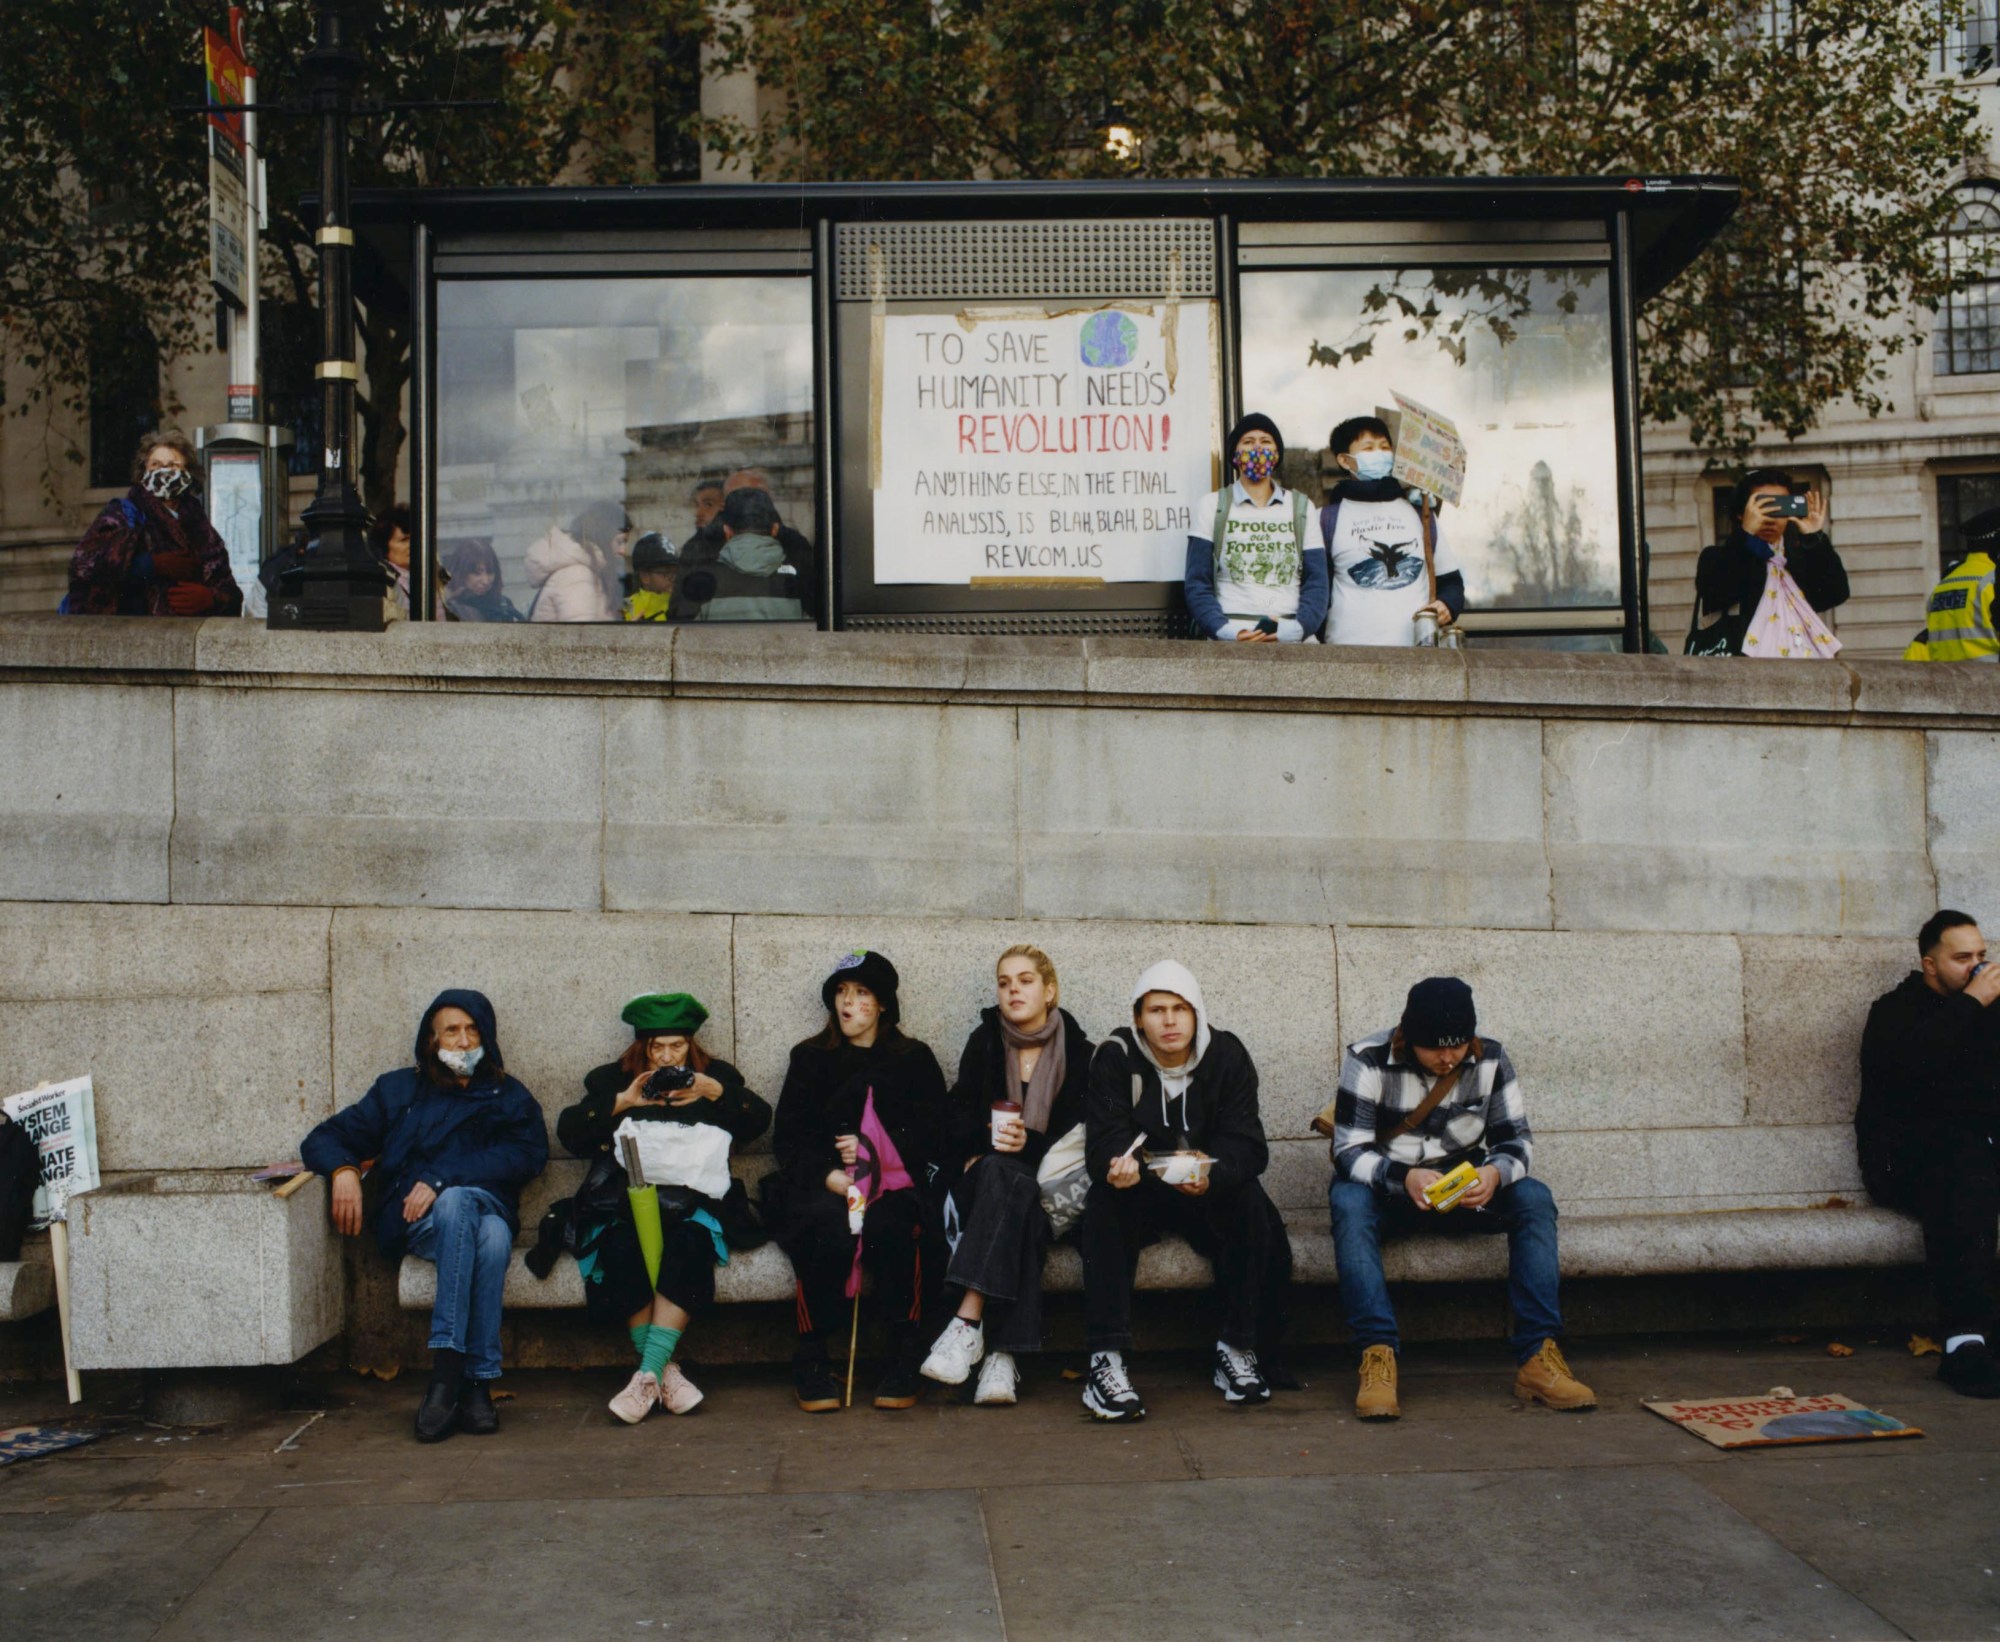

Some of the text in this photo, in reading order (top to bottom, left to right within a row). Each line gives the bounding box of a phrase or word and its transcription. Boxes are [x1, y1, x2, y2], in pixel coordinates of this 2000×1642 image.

[916, 331, 1050, 365] TO SAVE
[917, 373, 1068, 409] HUMANITY
[957, 413, 1171, 453] REVOLUTION!
[914, 470, 1012, 497] ANYTHING
[1062, 472, 1081, 496] IN
[1085, 472, 1116, 495] THE
[1122, 470, 1177, 495] FINAL
[922, 507, 1192, 538] ANALYSIS, IS BLAH, BLAH, BLAH
[1227, 519, 1295, 533] Protect
[1351, 523, 1382, 536] Plastic
[985, 544, 1104, 569] REVCOM.US
[1226, 540, 1296, 555] Forests!
[41, 1090, 66, 1103] Worker
[26, 1116, 71, 1143] ANGE
